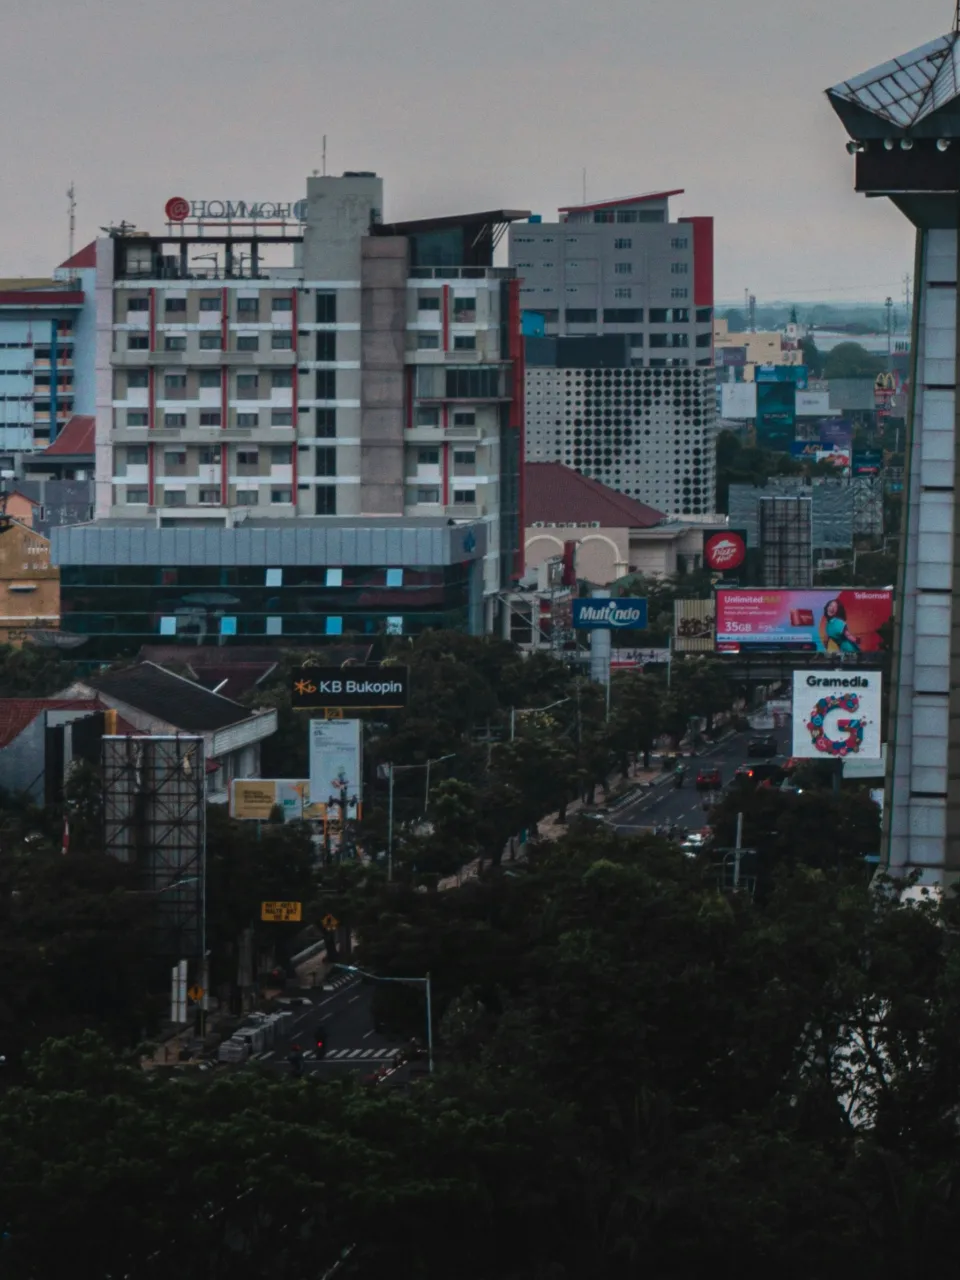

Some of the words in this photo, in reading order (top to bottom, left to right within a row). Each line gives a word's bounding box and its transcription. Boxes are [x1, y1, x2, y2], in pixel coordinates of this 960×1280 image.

[854, 591, 890, 600] Telkomsel
[579, 601, 641, 625] Multindo
[320, 680, 342, 693] KB
[345, 680, 403, 695] Bukopin
[806, 675, 869, 687] Gramedia
